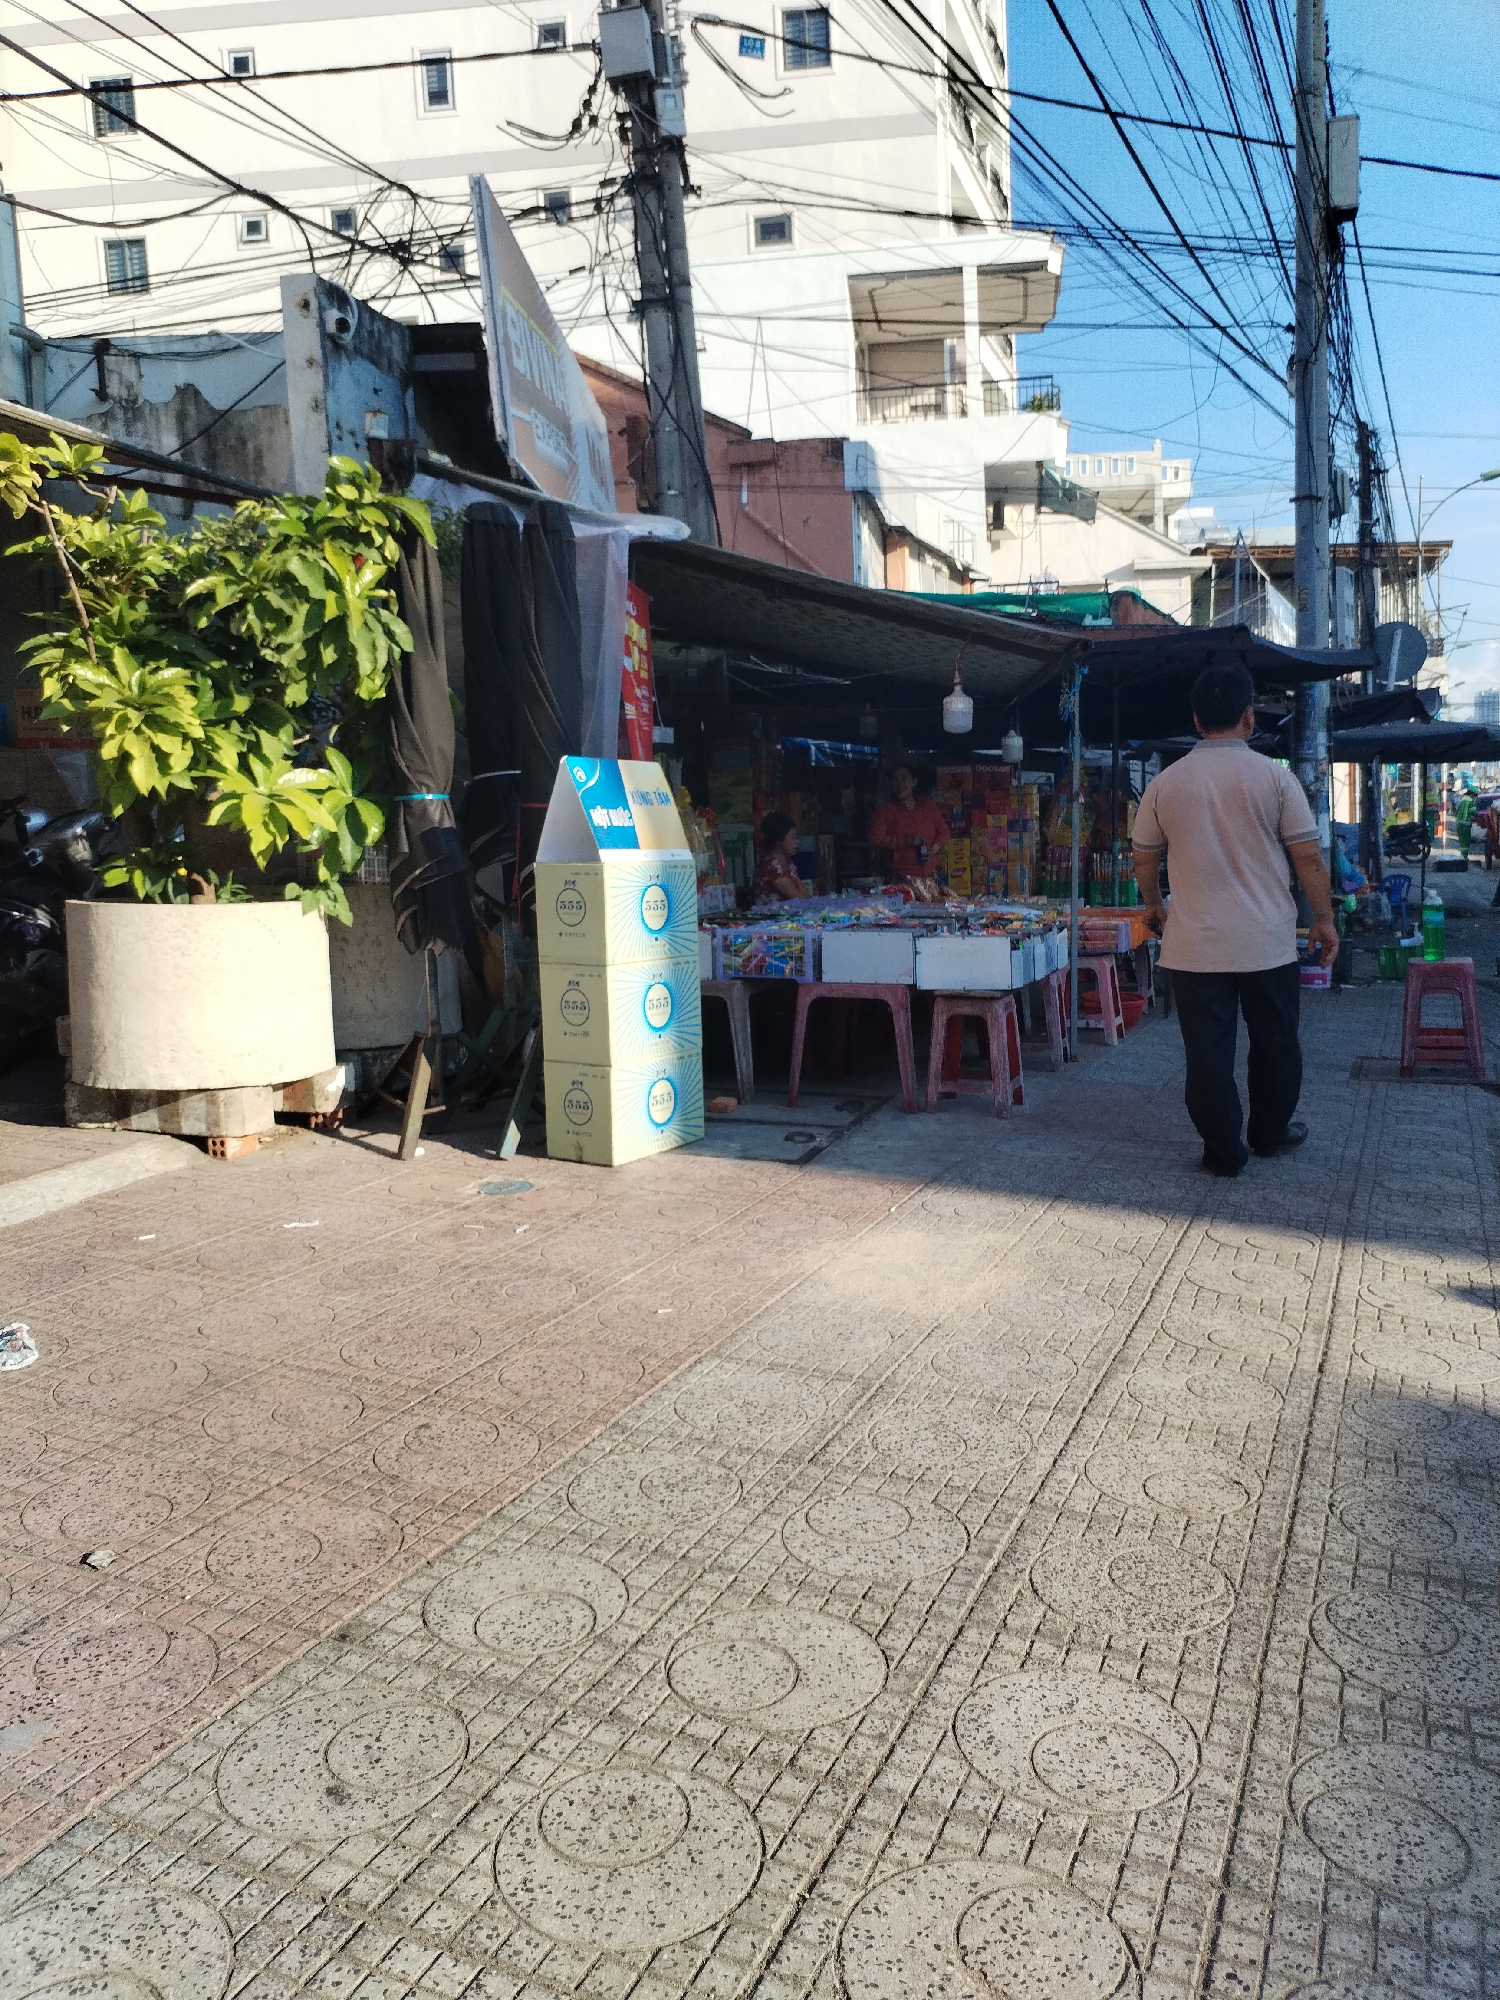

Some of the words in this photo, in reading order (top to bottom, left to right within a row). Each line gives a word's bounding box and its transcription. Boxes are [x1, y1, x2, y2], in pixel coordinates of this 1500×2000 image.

[559, 900, 583, 911] 555
[644, 899, 666, 912] 555
[563, 999, 587, 1011] 555
[647, 995, 670, 1011] 555
[566, 1099, 591, 1112] 555
[651, 1091, 673, 1108] 555
